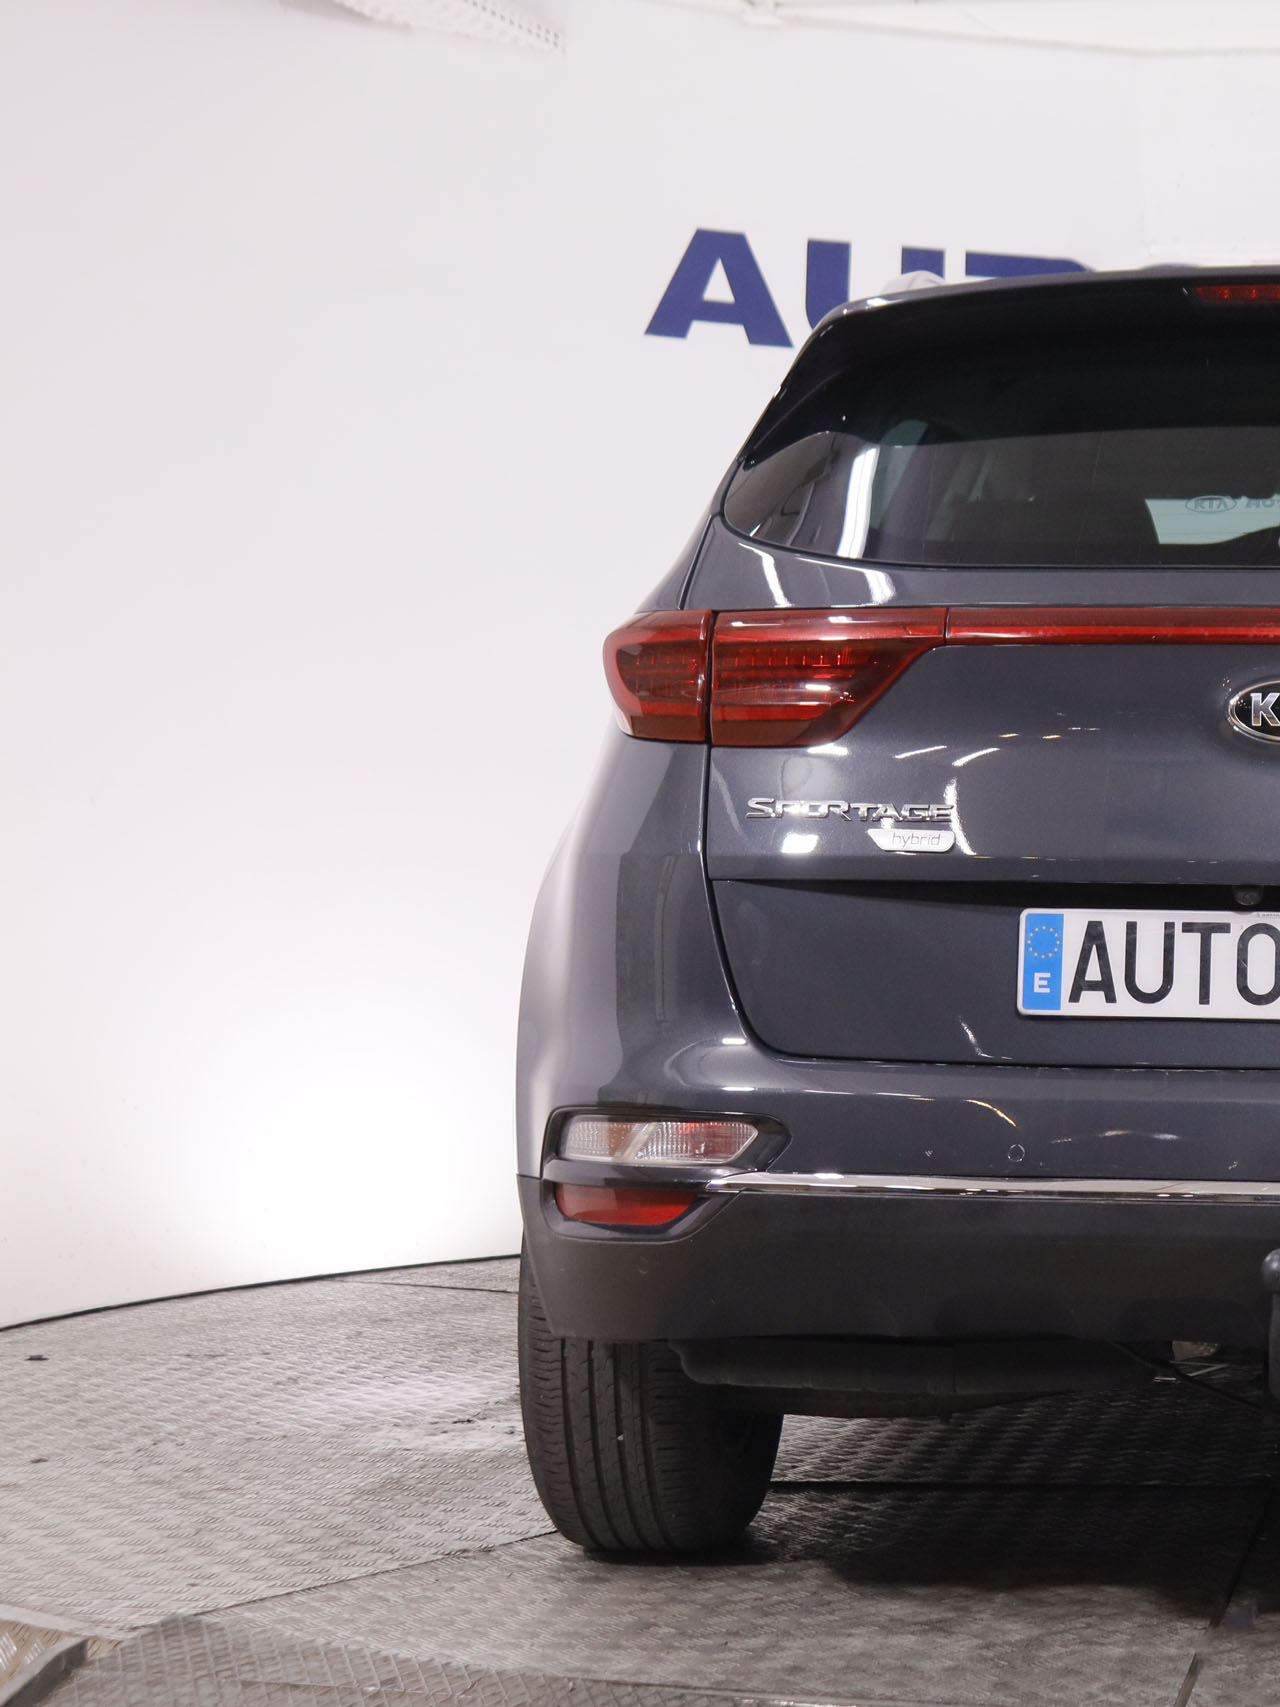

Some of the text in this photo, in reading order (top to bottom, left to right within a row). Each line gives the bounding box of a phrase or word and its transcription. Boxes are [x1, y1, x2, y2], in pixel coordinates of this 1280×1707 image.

[746, 797, 954, 822] SPORTAGE
[892, 832, 941, 847] hybrid
[1033, 972, 1051, 993] E
